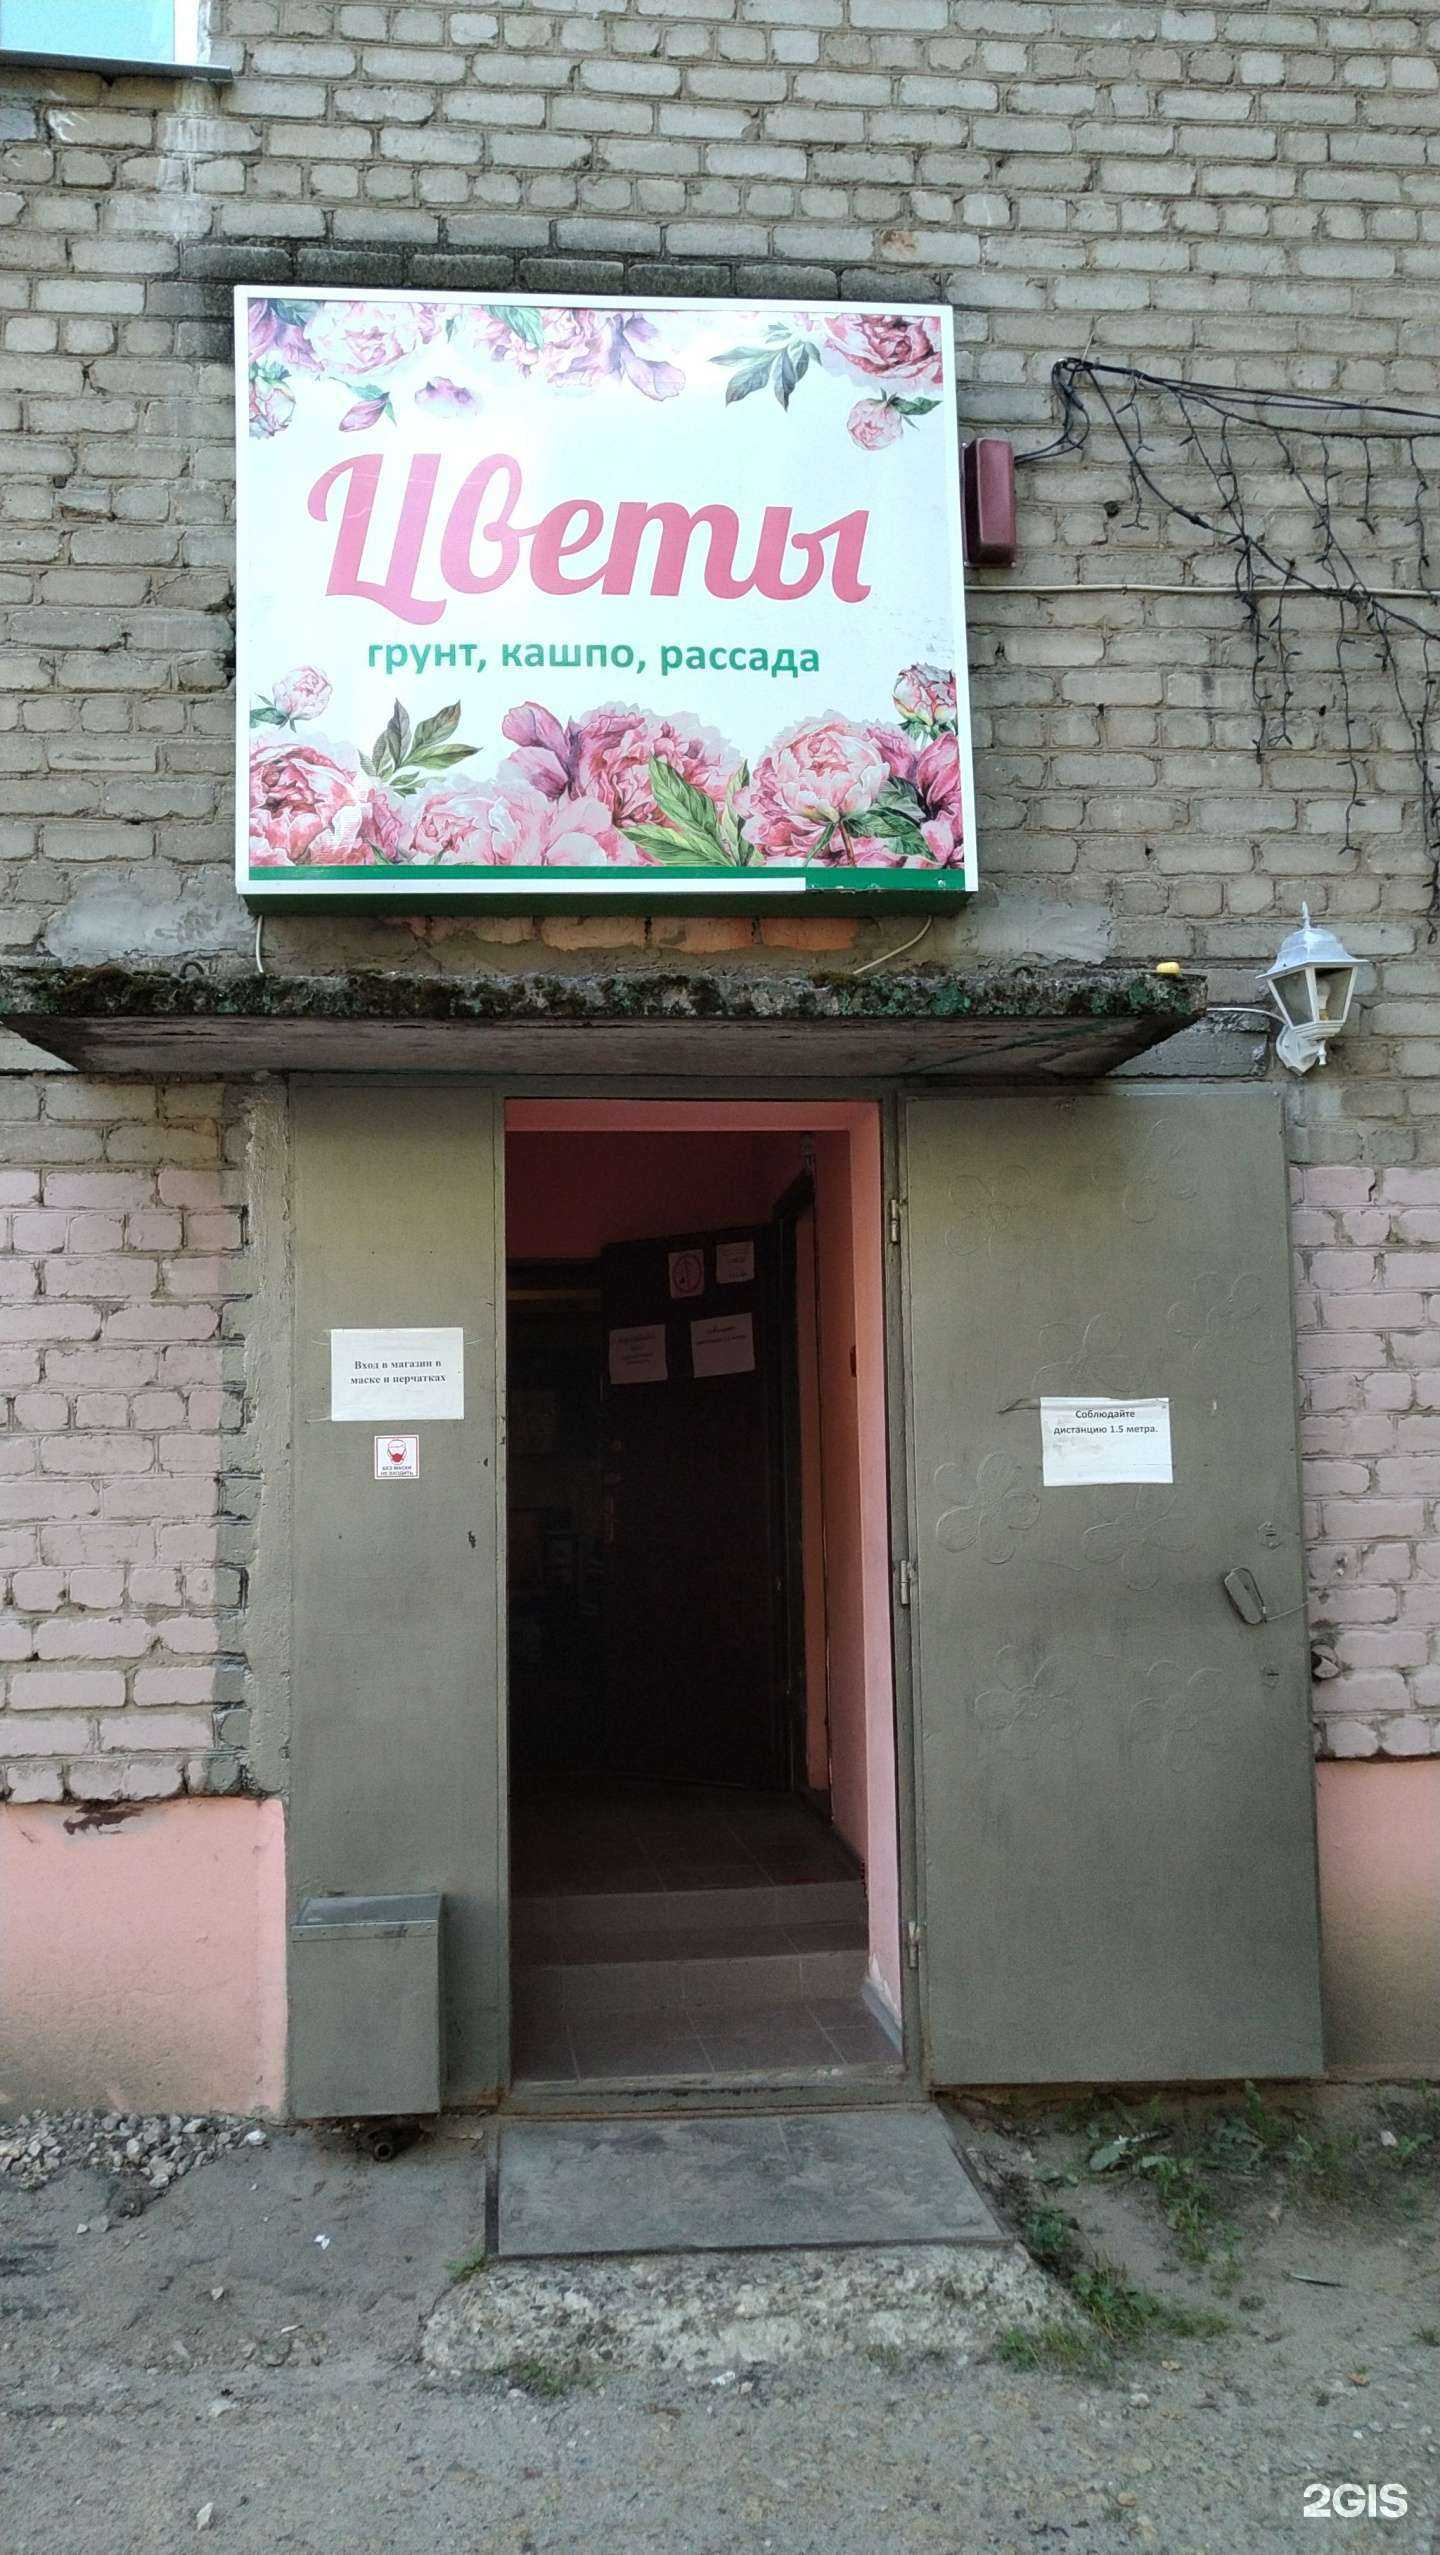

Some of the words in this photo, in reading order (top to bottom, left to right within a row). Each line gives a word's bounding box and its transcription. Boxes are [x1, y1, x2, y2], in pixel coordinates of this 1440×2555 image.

[308, 453, 871, 625] Цветы
[367, 641, 487, 674] грунт,
[501, 641, 646, 674] кашпо,
[660, 643, 820, 678] рассада
[354, 1360, 379, 1369] Вход
[382, 1361, 388, 1369] в
[350, 1376, 381, 1384] маске
[393, 1375, 446, 1384] перчатках
[1075, 1410, 1135, 1419] Соблюдайте
[1053, 1426, 1107, 1435] дистанцию
[1110, 1425, 1124, 1433] 1.5
[1126, 1426, 1159, 1434] метра.
